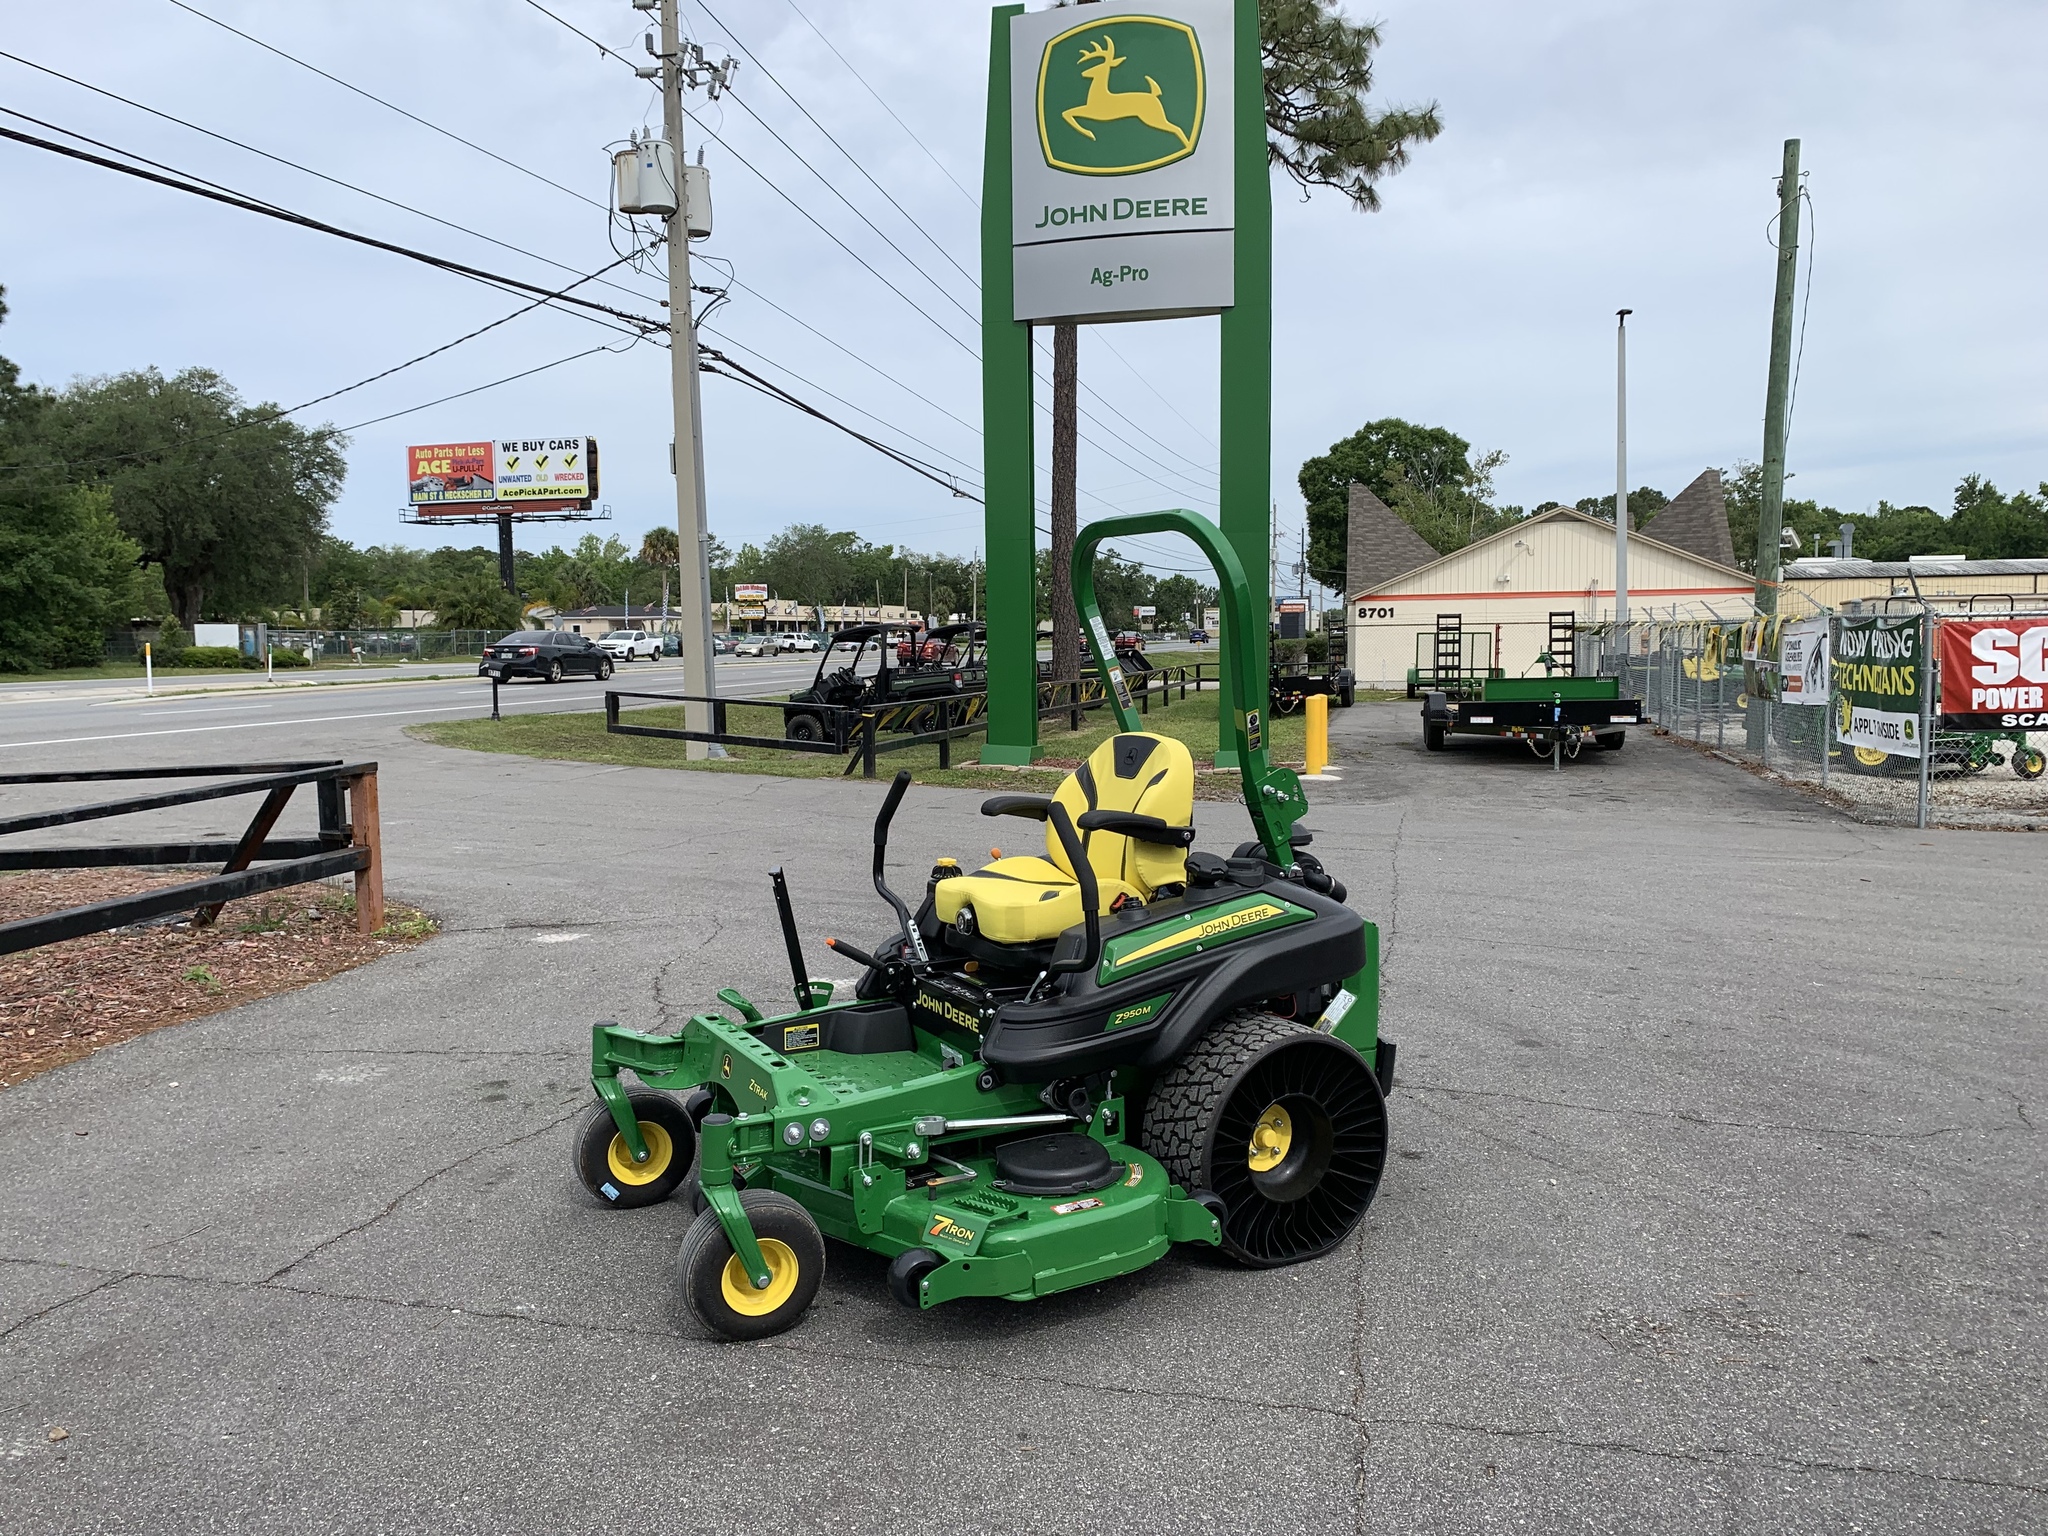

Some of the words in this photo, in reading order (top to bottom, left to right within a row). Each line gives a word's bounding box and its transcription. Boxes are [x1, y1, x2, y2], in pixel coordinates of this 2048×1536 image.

[1035, 203, 1107, 229] JOHN
[1113, 197, 1208, 221] DEERE
[1090, 265, 1149, 287] Ag-Pro
[415, 448, 432, 459] Auto
[434, 447, 453, 458] Parts
[455, 446, 466, 457] for
[468, 445, 485, 456] Less
[501, 442, 519, 453] WE
[522, 440, 545, 452] BUY
[549, 439, 579, 451] CARS
[416, 459, 452, 475] ACE
[452, 465, 485, 473] U-PULL-IT
[498, 474, 533, 484] UNWANTED
[535, 474, 549, 482] OLD
[554, 472, 585, 481] WRECKED
[412, 491, 429, 501] MAIN
[429, 491, 437, 500] ST
[438, 491, 444, 500] &
[445, 490, 482, 500] HECKSCHER
[483, 489, 493, 498] DR
[502, 487, 582, 497] AcePickAPart.com
[1358, 607, 1394, 618] 8701
[1839, 629, 1869, 657] NOW
[1871, 628, 1914, 659] HRING
[1971, 686, 2043, 710] POWER
[1199, 919, 1230, 937] JOHN
[1231, 907, 1269, 926] DEERE
[916, 989, 943, 1015] JOHN
[944, 1001, 979, 1033] DEERE
[1114, 1005, 1151, 1025] Z950M
[749, 1078, 769, 1101] ZTRAK
